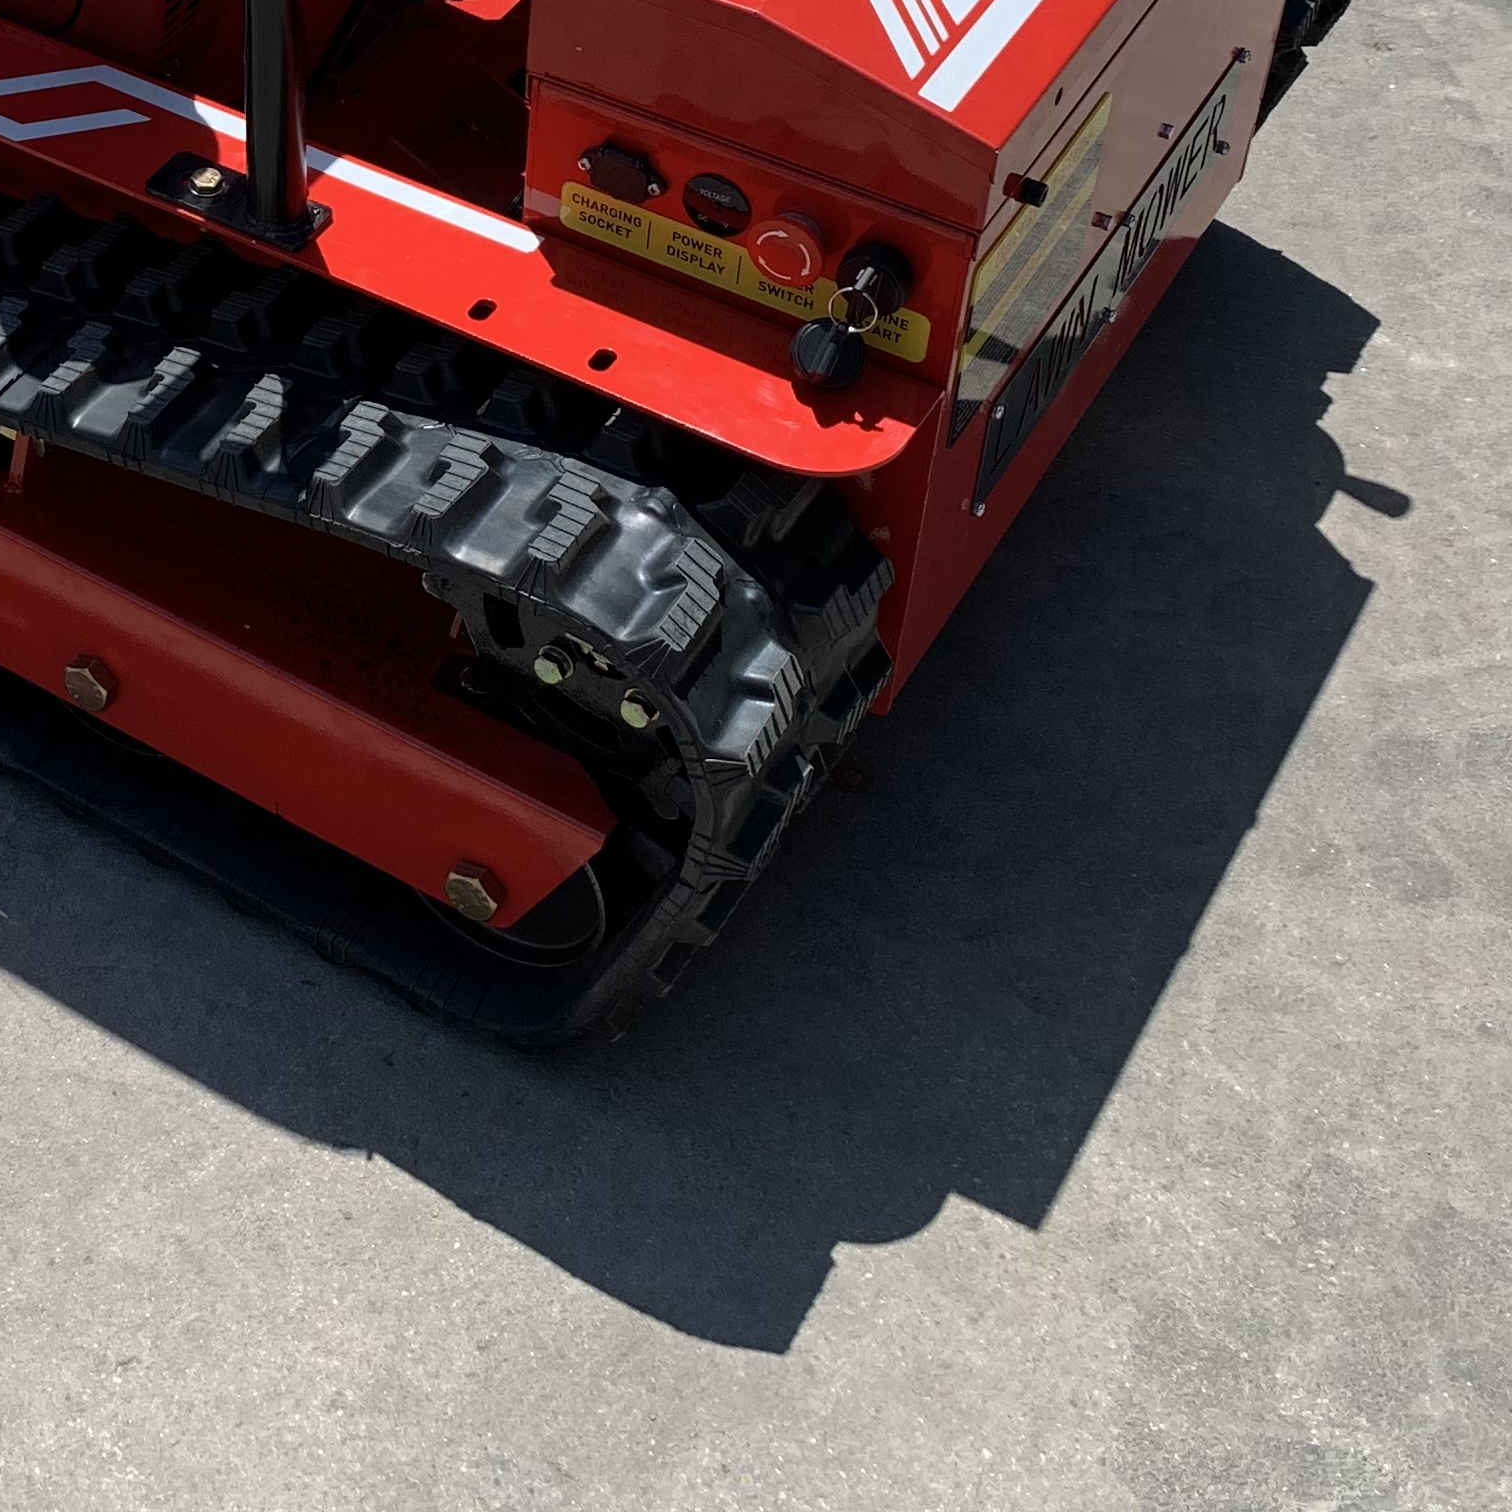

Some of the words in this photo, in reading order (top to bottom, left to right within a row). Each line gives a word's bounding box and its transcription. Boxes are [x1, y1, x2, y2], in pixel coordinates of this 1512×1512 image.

[571, 192, 642, 228] CHARGING
[699, 187, 731, 204] VOLTAGE
[1112, 93, 1226, 297] MOWER
[578, 211, 633, 239] SOCKET
[666, 244, 726, 276] DISPLAY
[672, 231, 723, 260] POWER
[757, 280, 814, 310] SWITCH
[990, 273, 1099, 474] LAWN
